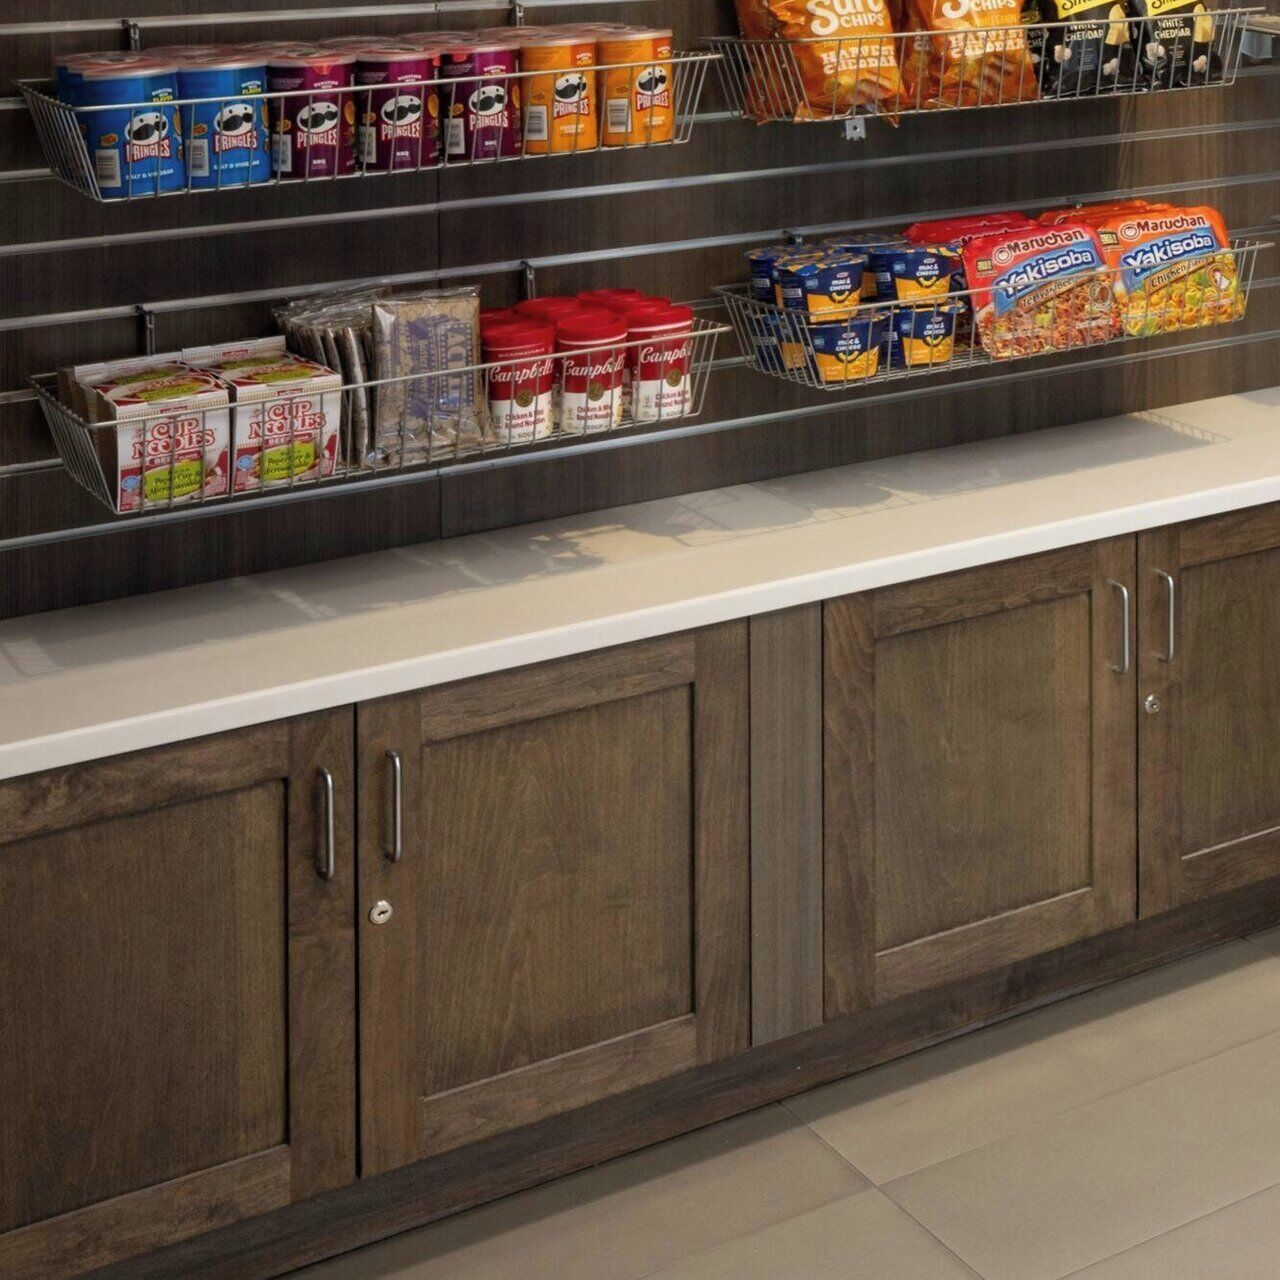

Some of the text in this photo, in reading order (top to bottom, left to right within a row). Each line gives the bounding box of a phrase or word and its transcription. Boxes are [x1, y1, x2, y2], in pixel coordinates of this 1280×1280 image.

[840, 11, 884, 29] CHIPS
[821, 44, 895, 63] HARVEST
[554, 99, 589, 117] PRINGLES
[637, 92, 669, 109] PRINGLES
[381, 122, 422, 141] PRINGLES
[469, 111, 508, 131] PRINGLES
[215, 131, 258, 153] PRINGLES
[297, 128, 338, 149] PRINGLES
[126, 137, 170, 162] PRINGLES
[1136, 215, 1206, 234] Maruchan
[1007, 229, 1085, 254] Maruchan
[1125, 234, 1213, 271] Yakisoba
[999, 248, 1094, 295] Yakisoba
[1151, 264, 1186, 288] Chicken
[268, 401, 312, 420] CUP
[152, 417, 200, 440] CUP
[132, 429, 215, 460] NOODLES
